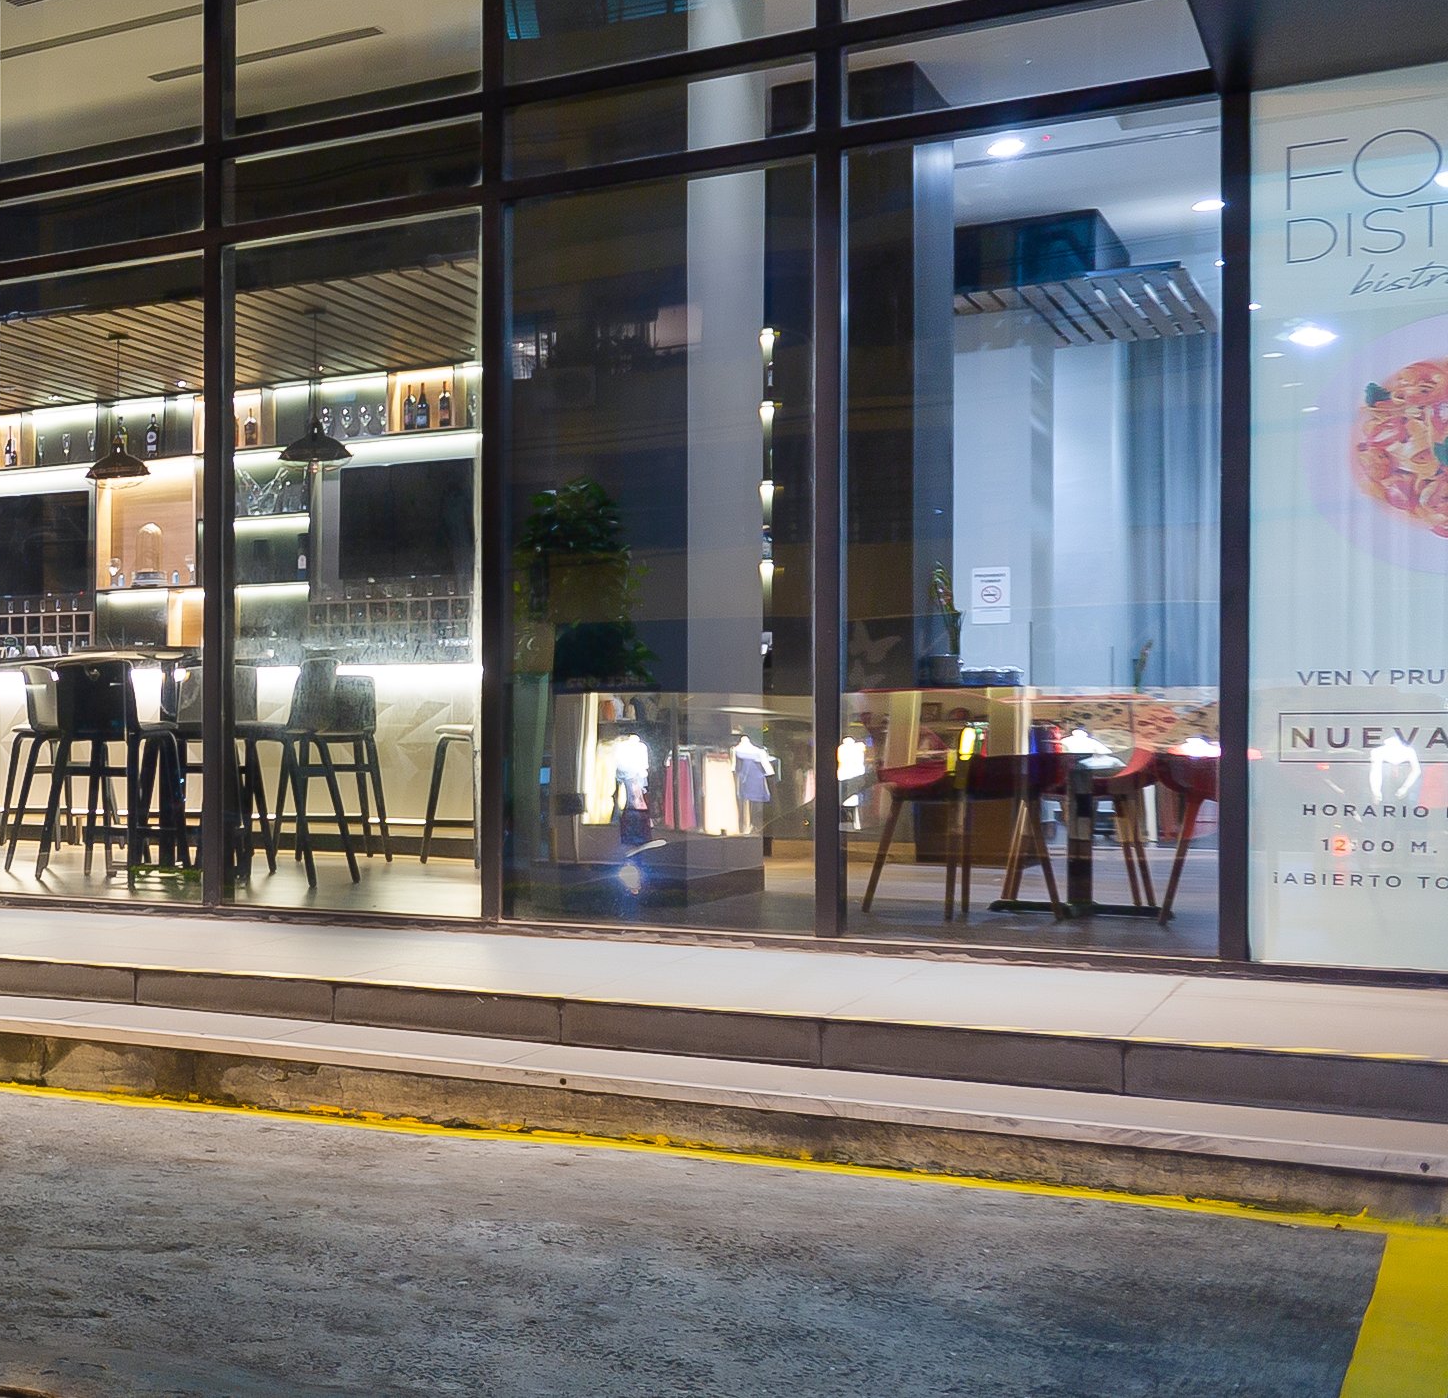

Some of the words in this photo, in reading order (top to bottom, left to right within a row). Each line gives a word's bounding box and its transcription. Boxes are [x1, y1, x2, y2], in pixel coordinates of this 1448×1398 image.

[1286, 129, 1442, 211] FO
[1286, 201, 1448, 264] DIST
[1350, 261, 1448, 295] bistr
[1297, 670, 1353, 686] VEN
[1361, 669, 1381, 685] Y
[1291, 727, 1448, 749] NUEVA
[1303, 804, 1430, 819] HORARIO
